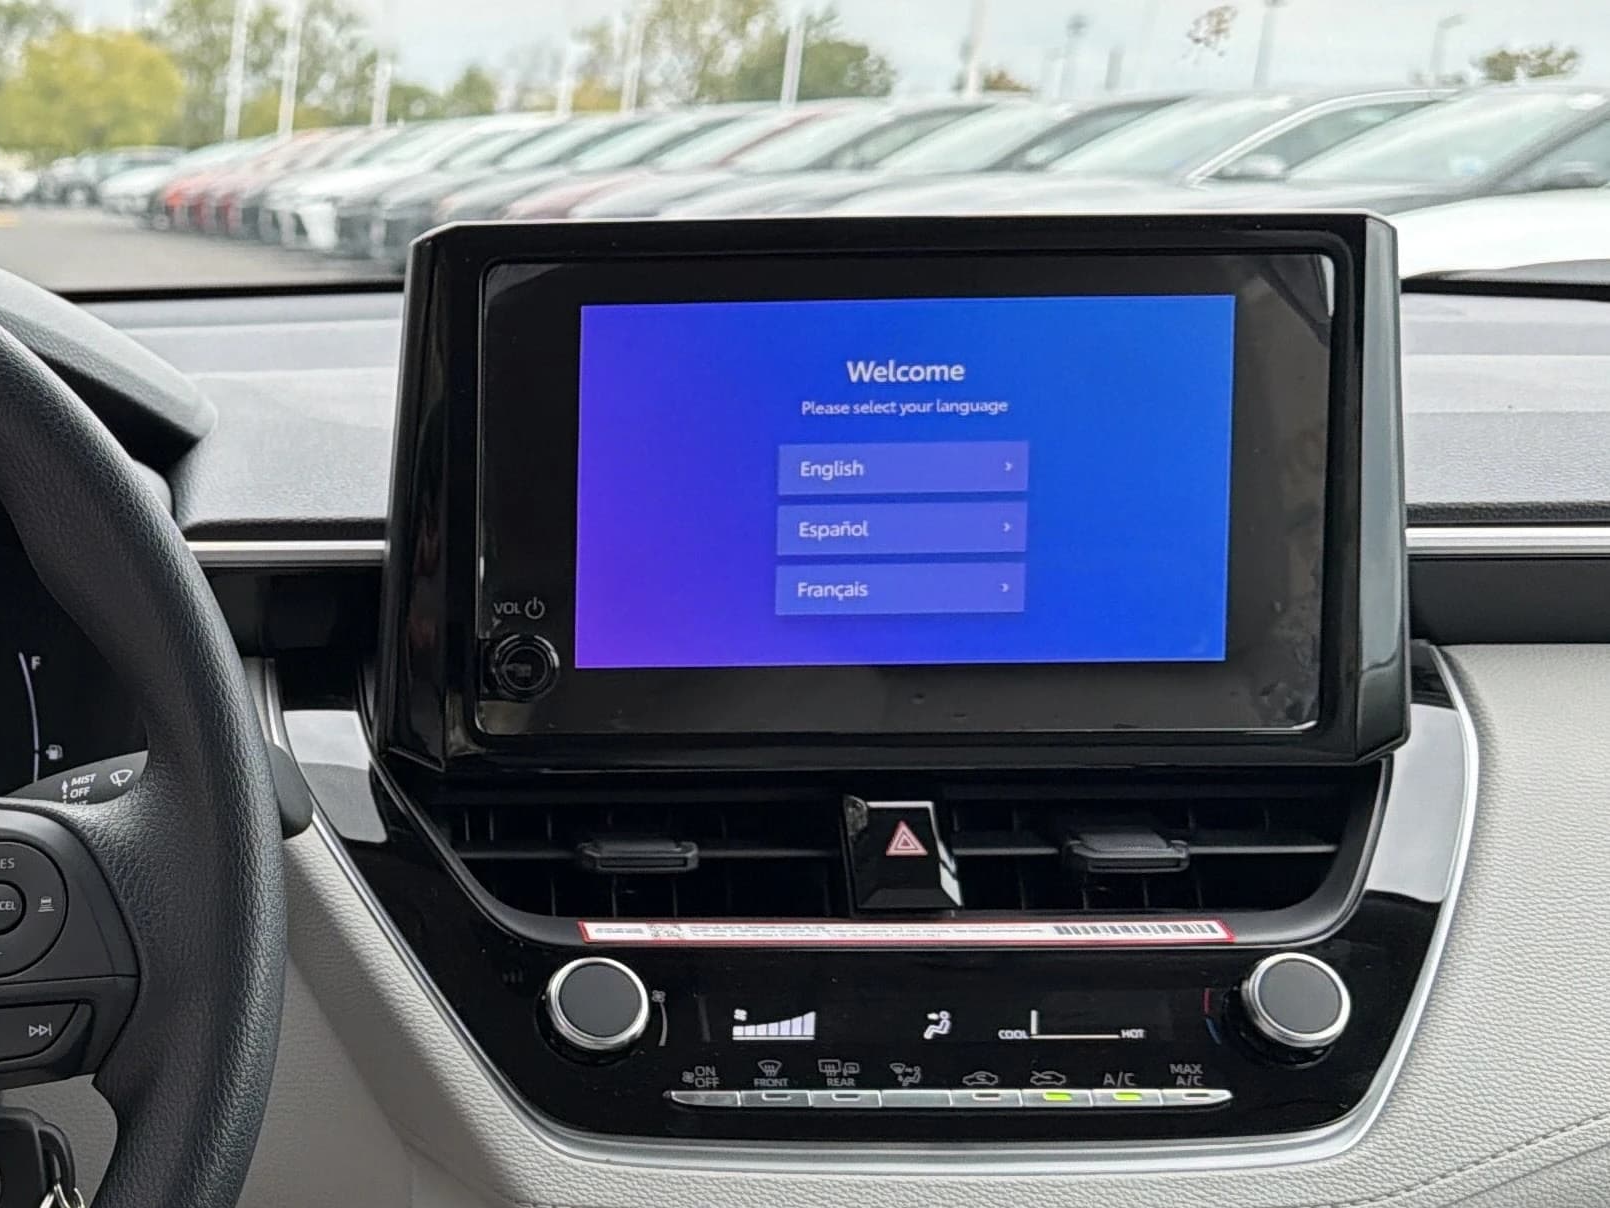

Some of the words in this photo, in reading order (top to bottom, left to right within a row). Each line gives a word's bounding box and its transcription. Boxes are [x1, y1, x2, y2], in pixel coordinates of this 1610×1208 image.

[847, 359, 966, 383] Welcome
[801, 400, 850, 415] Please
[853, 400, 897, 415] select
[898, 401, 934, 417] your
[936, 398, 1009, 416] language
[799, 459, 865, 481] English
[798, 520, 869, 541] Español
[797, 581, 869, 601] Français
[493, 601, 522, 615] VOL
[31, 656, 42, 671] F
[70, 773, 97, 787] MIST
[70, 787, 91, 799] OFF
[997, 1029, 1030, 1040] COOL
[1121, 1029, 1145, 1039] HOT
[694, 1065, 716, 1077] ON
[1169, 1063, 1203, 1075] MAX
[694, 1077, 720, 1088] OFF
[753, 1077, 789, 1088] FRONT
[826, 1077, 855, 1088] REAR
[1102, 1072, 1135, 1087] A/C
[1176, 1075, 1202, 1087] A/C
